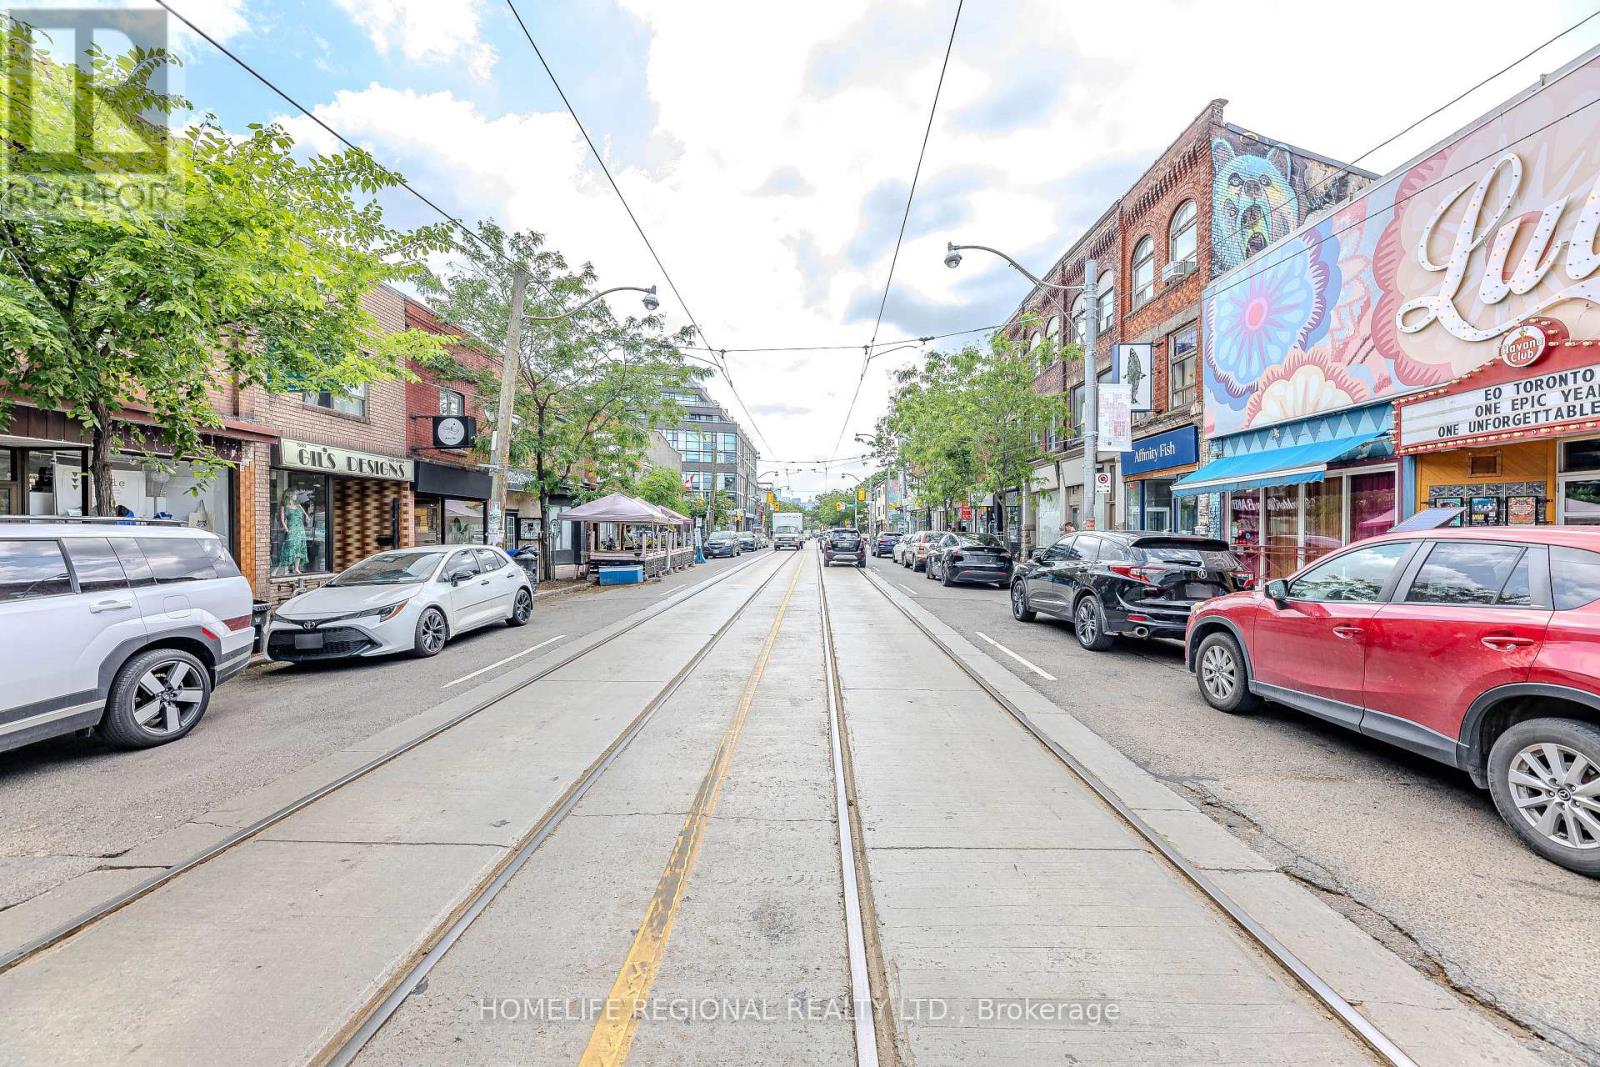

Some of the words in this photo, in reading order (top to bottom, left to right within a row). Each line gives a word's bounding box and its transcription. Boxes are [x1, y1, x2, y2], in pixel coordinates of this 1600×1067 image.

[1502, 338, 1544, 354] Havana
[1510, 351, 1534, 363] Club
[1484, 387, 1502, 401] EO
[1514, 368, 1595, 396] TORONTO
[1475, 402, 1501, 418] ONE
[1511, 393, 1547, 411] EPIC
[1561, 385, 1600, 403] YEA
[1438, 424, 1459, 438] ONE
[1468, 400, 1600, 433] UNFORGETTABLE
[1134, 447, 1158, 463] Affinity
[1160, 441, 1176, 457] Fish
[346, 456, 405, 478] DESIGNS
